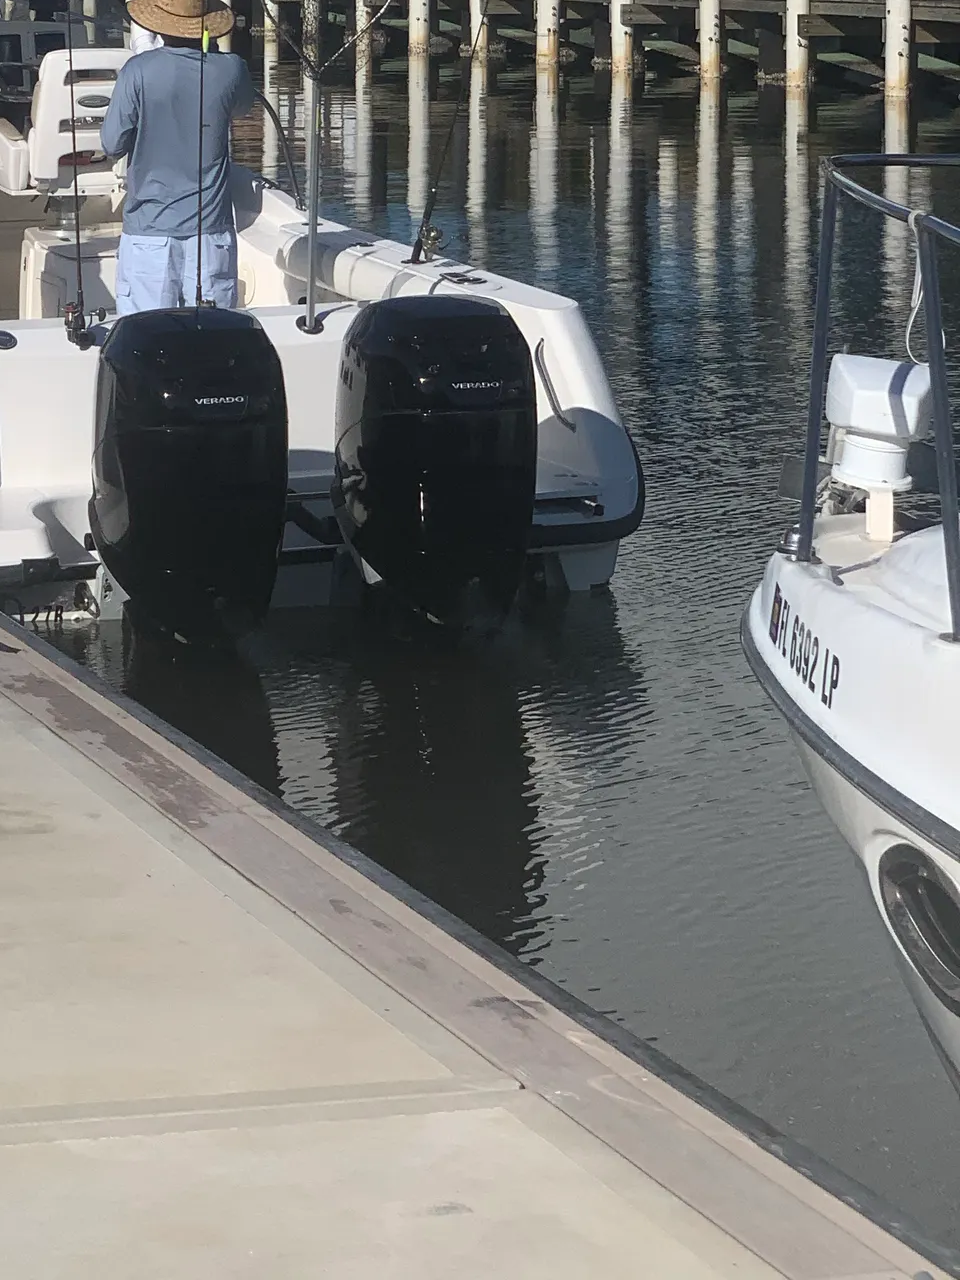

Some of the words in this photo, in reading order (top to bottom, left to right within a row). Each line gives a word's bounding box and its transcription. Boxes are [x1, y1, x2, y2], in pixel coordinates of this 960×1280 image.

[451, 381, 500, 389] VERADO
[194, 395, 245, 405] VERADO
[778, 599, 791, 658] FL
[790, 614, 820, 694] 6392
[821, 648, 840, 710] LP
